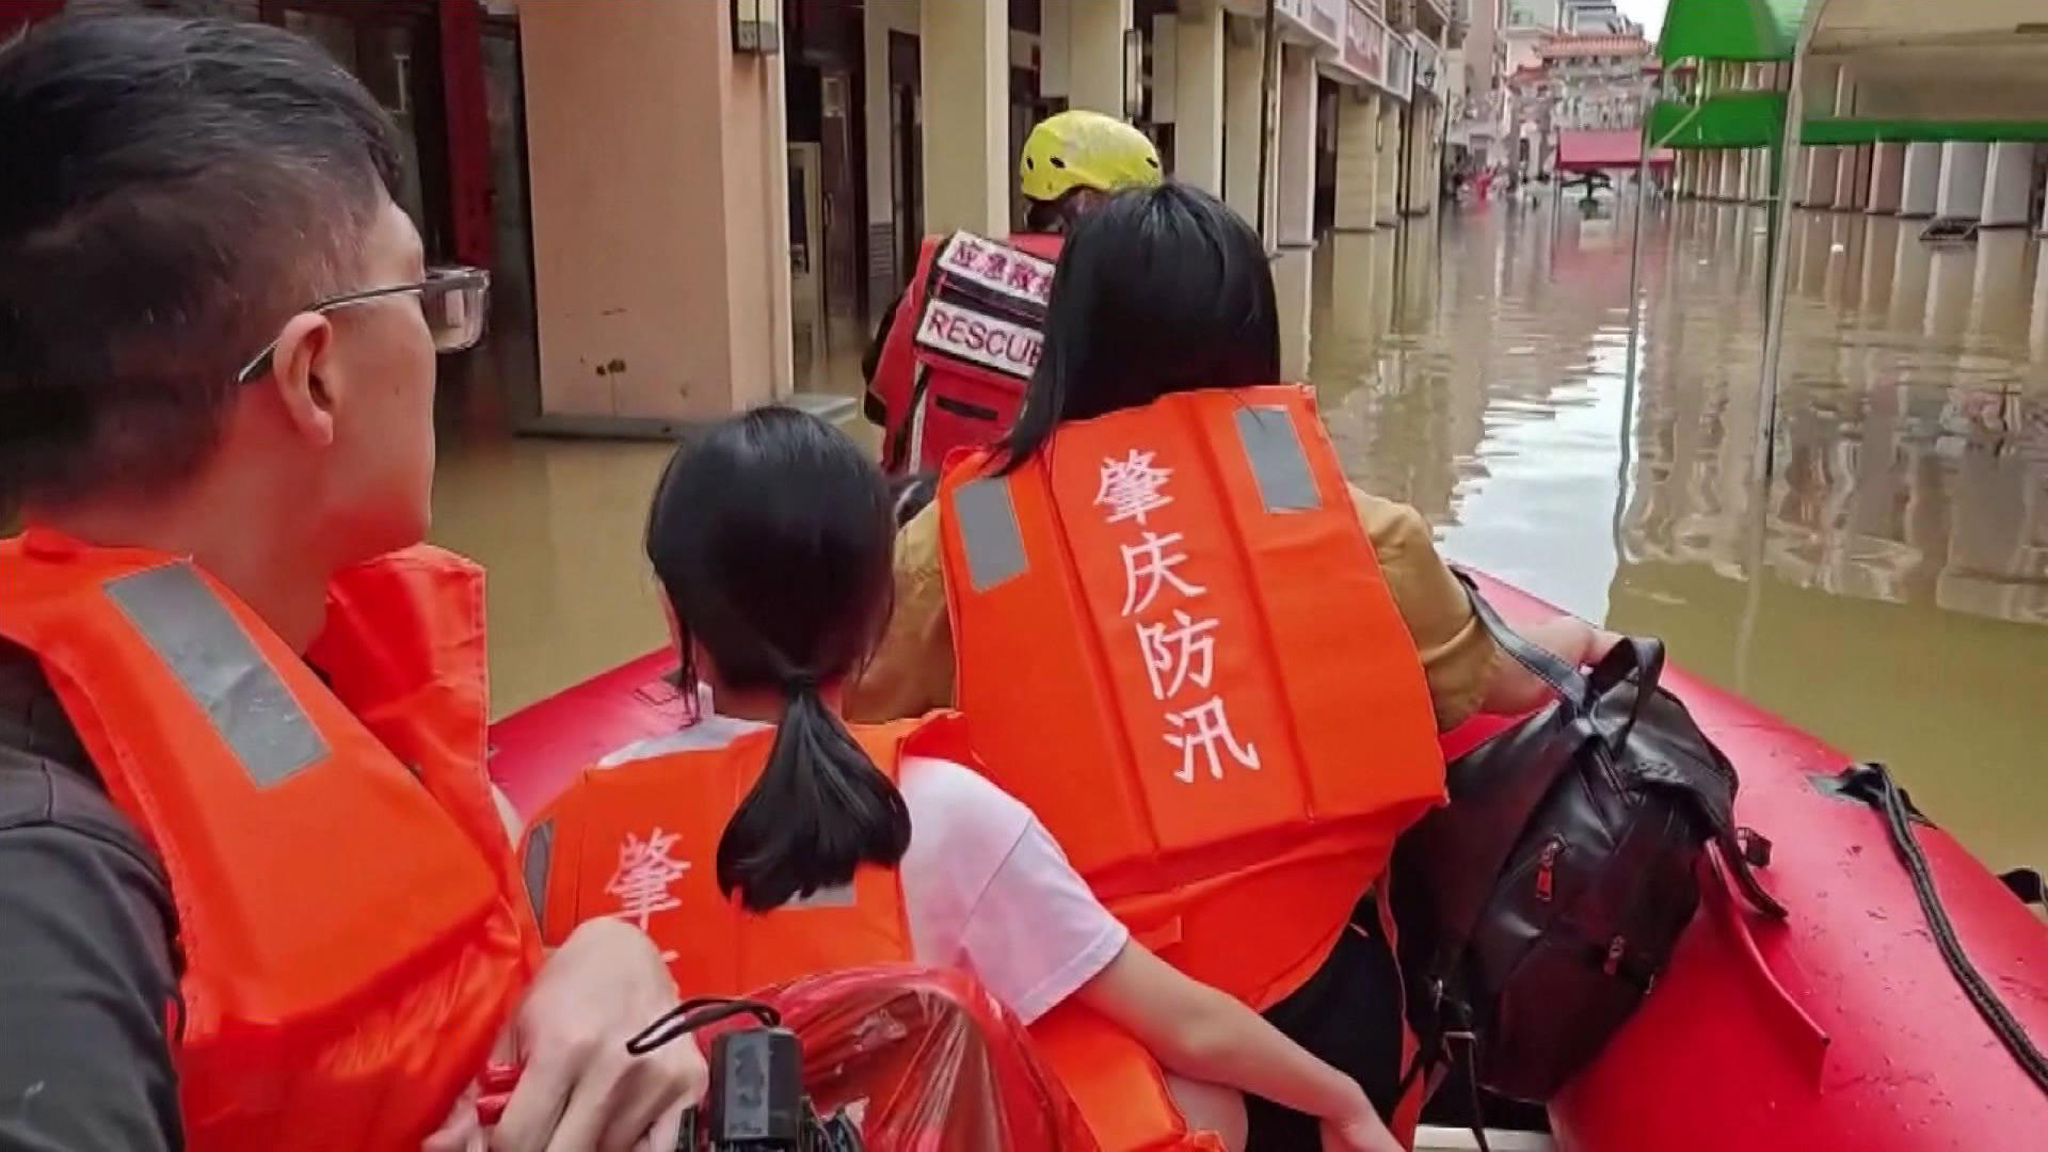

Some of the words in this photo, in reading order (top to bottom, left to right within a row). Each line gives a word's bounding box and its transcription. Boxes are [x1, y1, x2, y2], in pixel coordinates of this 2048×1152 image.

[927, 308, 1042, 367] RESCUE
[1093, 449, 1261, 784] 肇庆防汛
[604, 826, 692, 963] 肇
